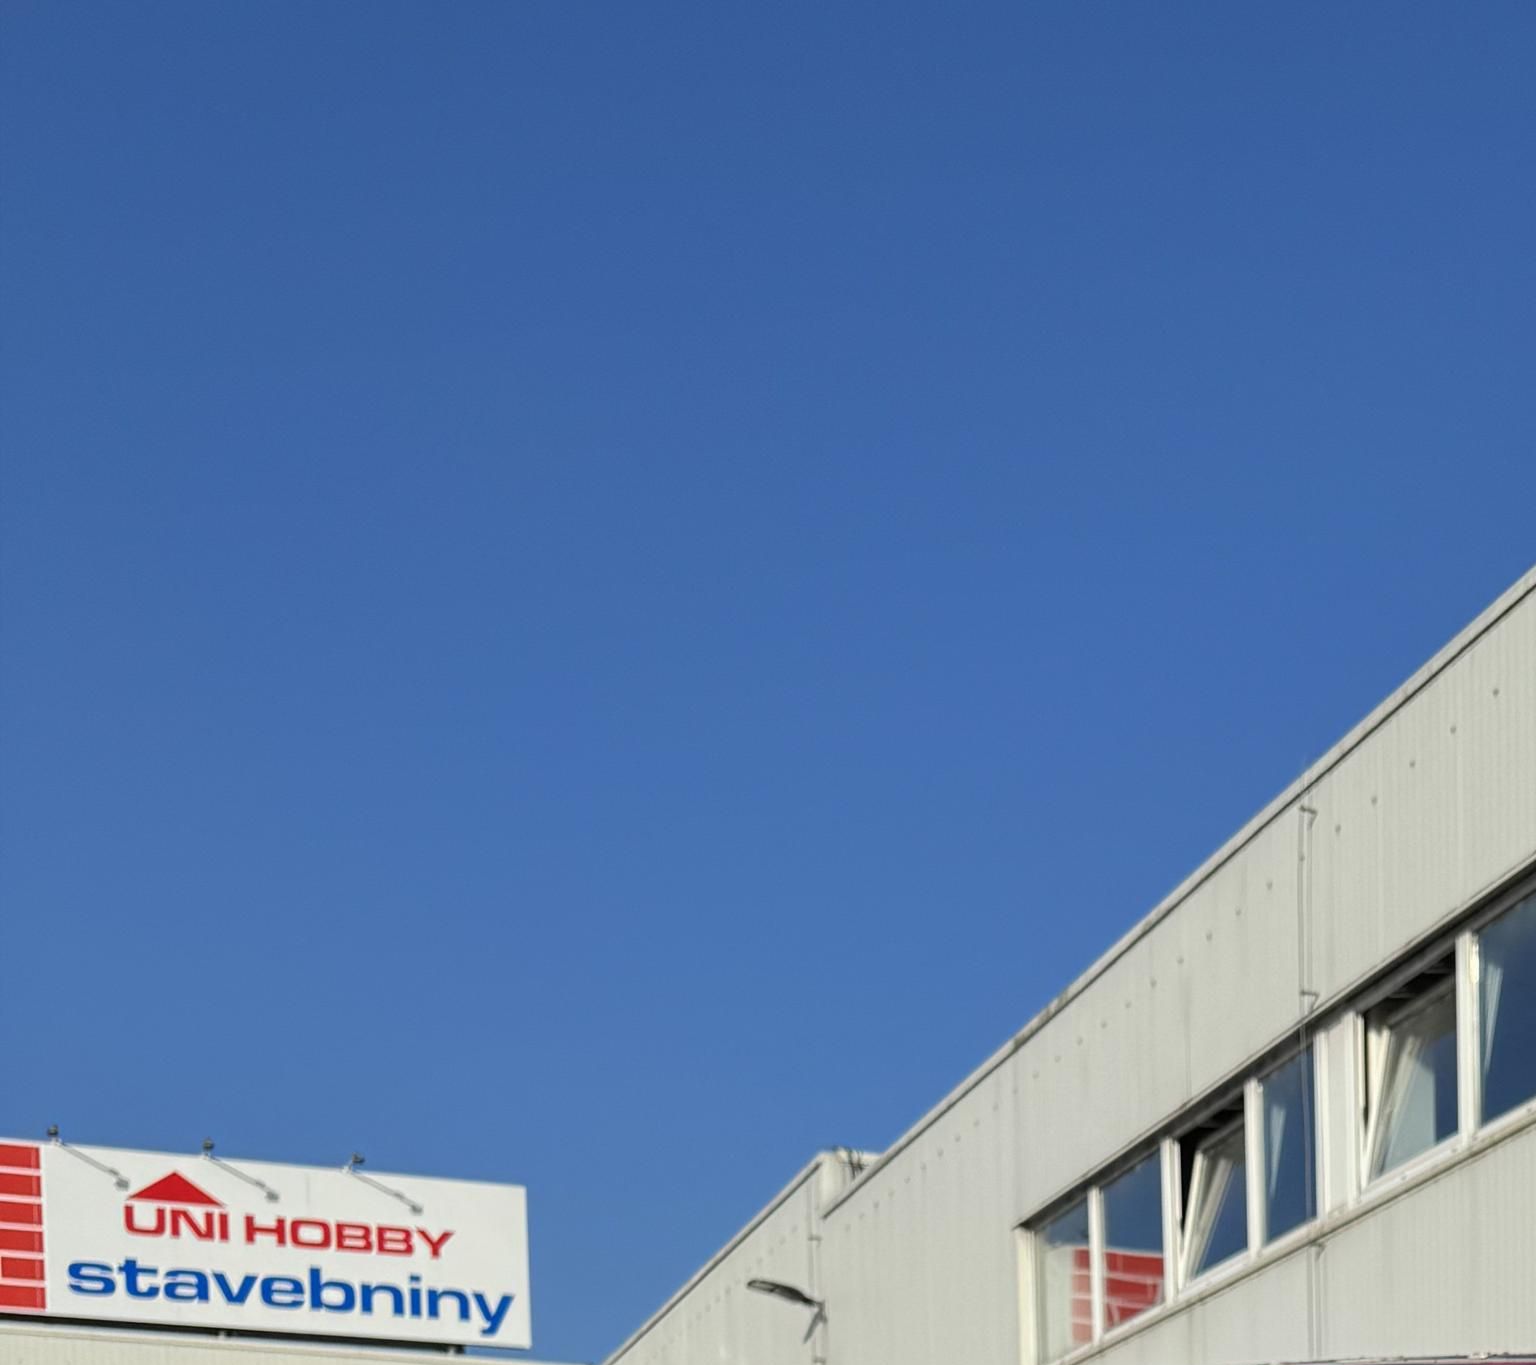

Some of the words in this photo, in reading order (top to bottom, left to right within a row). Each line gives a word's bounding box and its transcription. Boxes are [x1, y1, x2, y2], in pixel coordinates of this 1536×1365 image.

[124, 1205, 230, 1243] UNI
[245, 1214, 456, 1259] HOBBY
[67, 1257, 516, 1336] stavebniny
